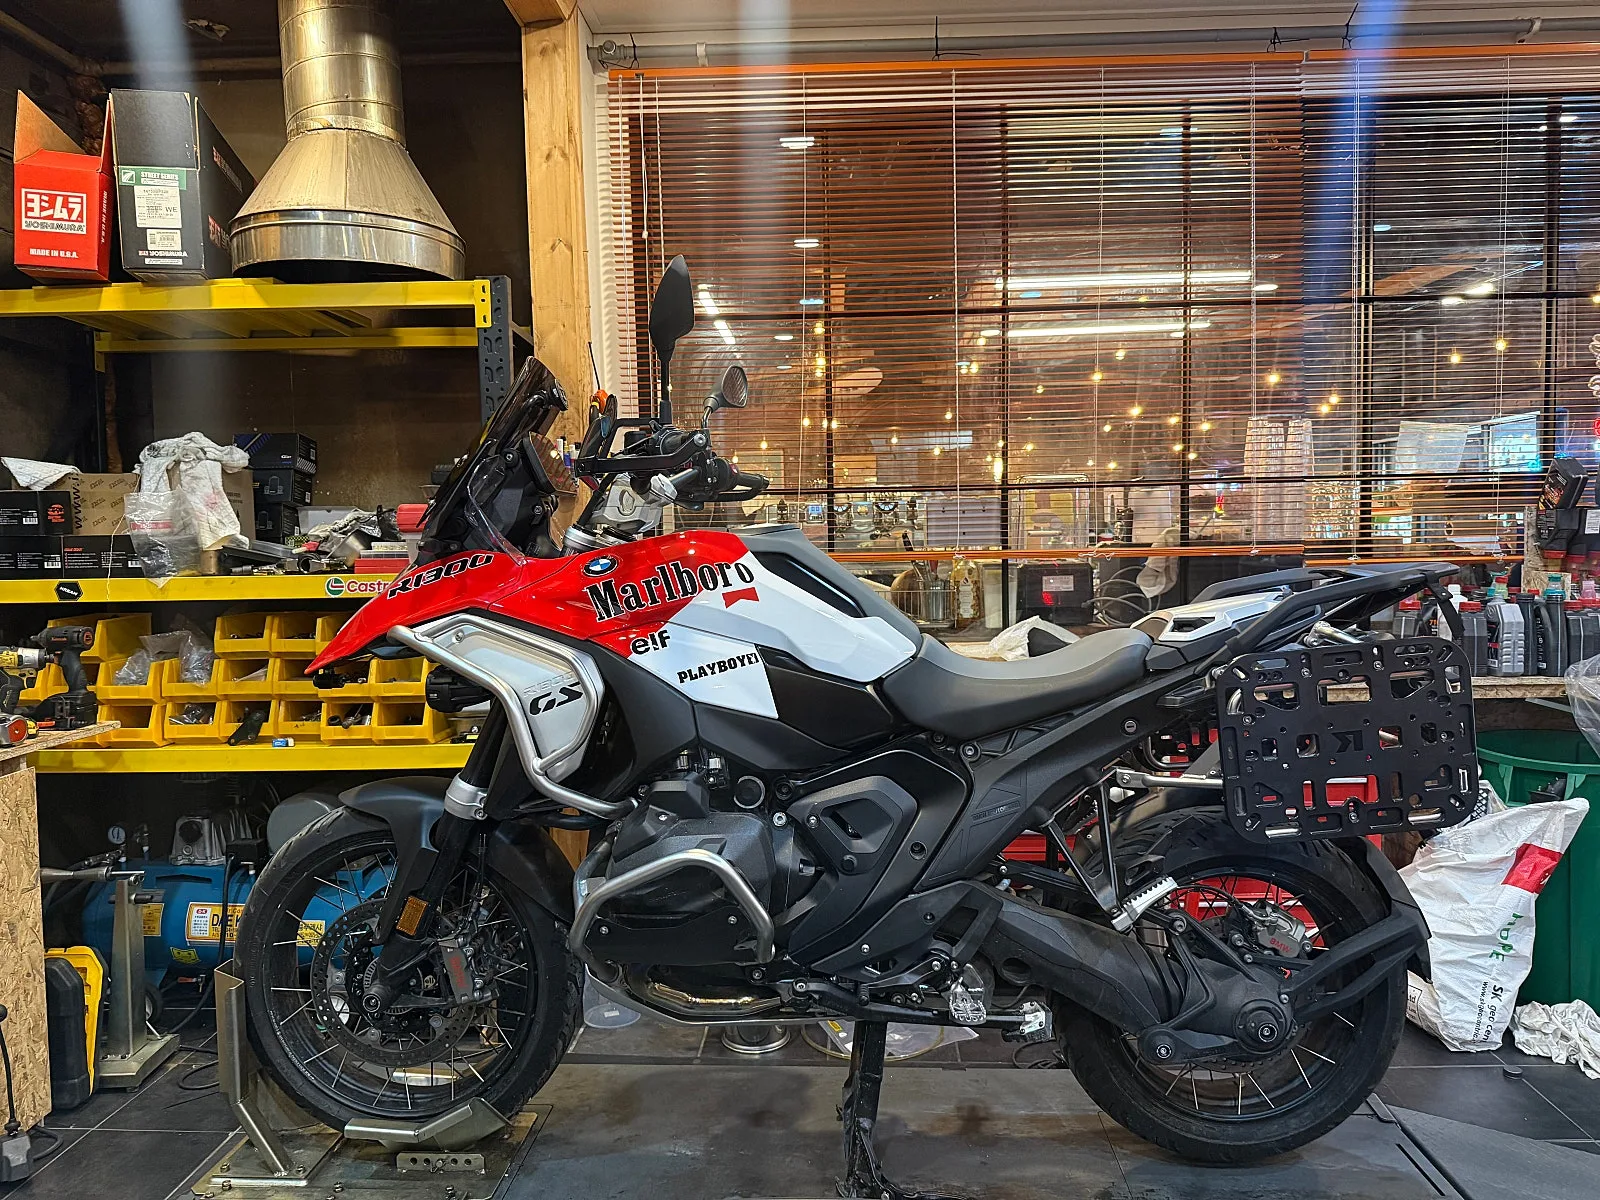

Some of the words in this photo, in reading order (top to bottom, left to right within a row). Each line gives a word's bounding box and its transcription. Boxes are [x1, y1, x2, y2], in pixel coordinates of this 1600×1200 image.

[26, 193, 82, 221] ヨシムラ
[24, 220, 86, 233] YOSHIMURA
[29, 248, 50, 257] MADE
[60, 250, 79, 259] U.S.A.
[346, 580, 389, 593] Castr
[387, 553, 495, 600] R1300
[585, 561, 755, 622] Marlboro
[631, 630, 671, 655] elf
[677, 655, 748, 683] PLAYBOY
[529, 681, 584, 716] GS
[1269, 937, 1292, 953] BMW
[1491, 984, 1504, 1002] SK
[1487, 1004, 1497, 1022] geo
